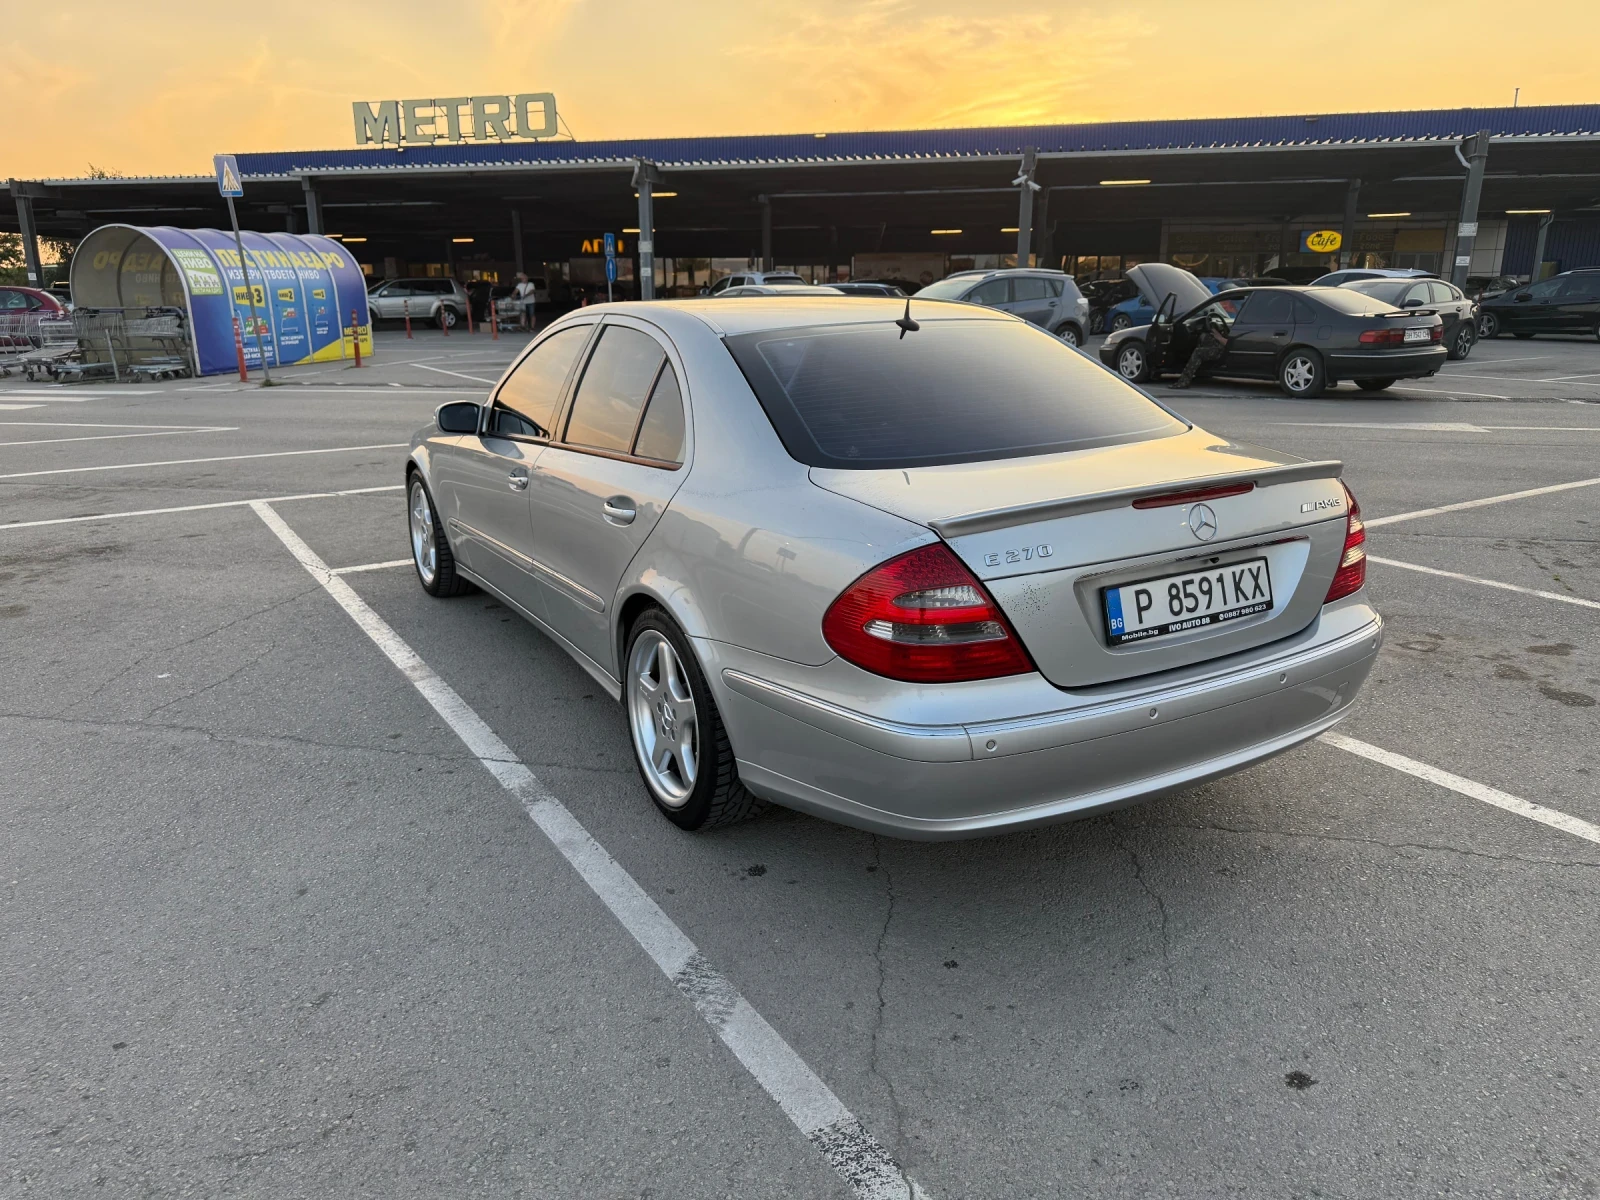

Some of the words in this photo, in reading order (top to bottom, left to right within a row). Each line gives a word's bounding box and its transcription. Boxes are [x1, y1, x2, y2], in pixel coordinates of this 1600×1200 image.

[352, 92, 558, 145] METRO
[179, 257, 213, 269] НИВО
[254, 288, 263, 303] 3
[288, 290, 294, 300] 2
[343, 326, 367, 336] MERO
[1315, 497, 1341, 509] AMG
[983, 552, 1001, 567] E
[1005, 543, 1054, 564] 270
[1134, 587, 1153, 625] P
[1111, 617, 1124, 630] BG
[1121, 629, 1159, 641] Mobile.bg
[1168, 621, 1182, 632] IVO
[1182, 619, 1201, 630] AUTO
[1201, 616, 1211, 625] 88
[1223, 609, 1240, 619] 0887
[1254, 603, 1267, 613] 623
